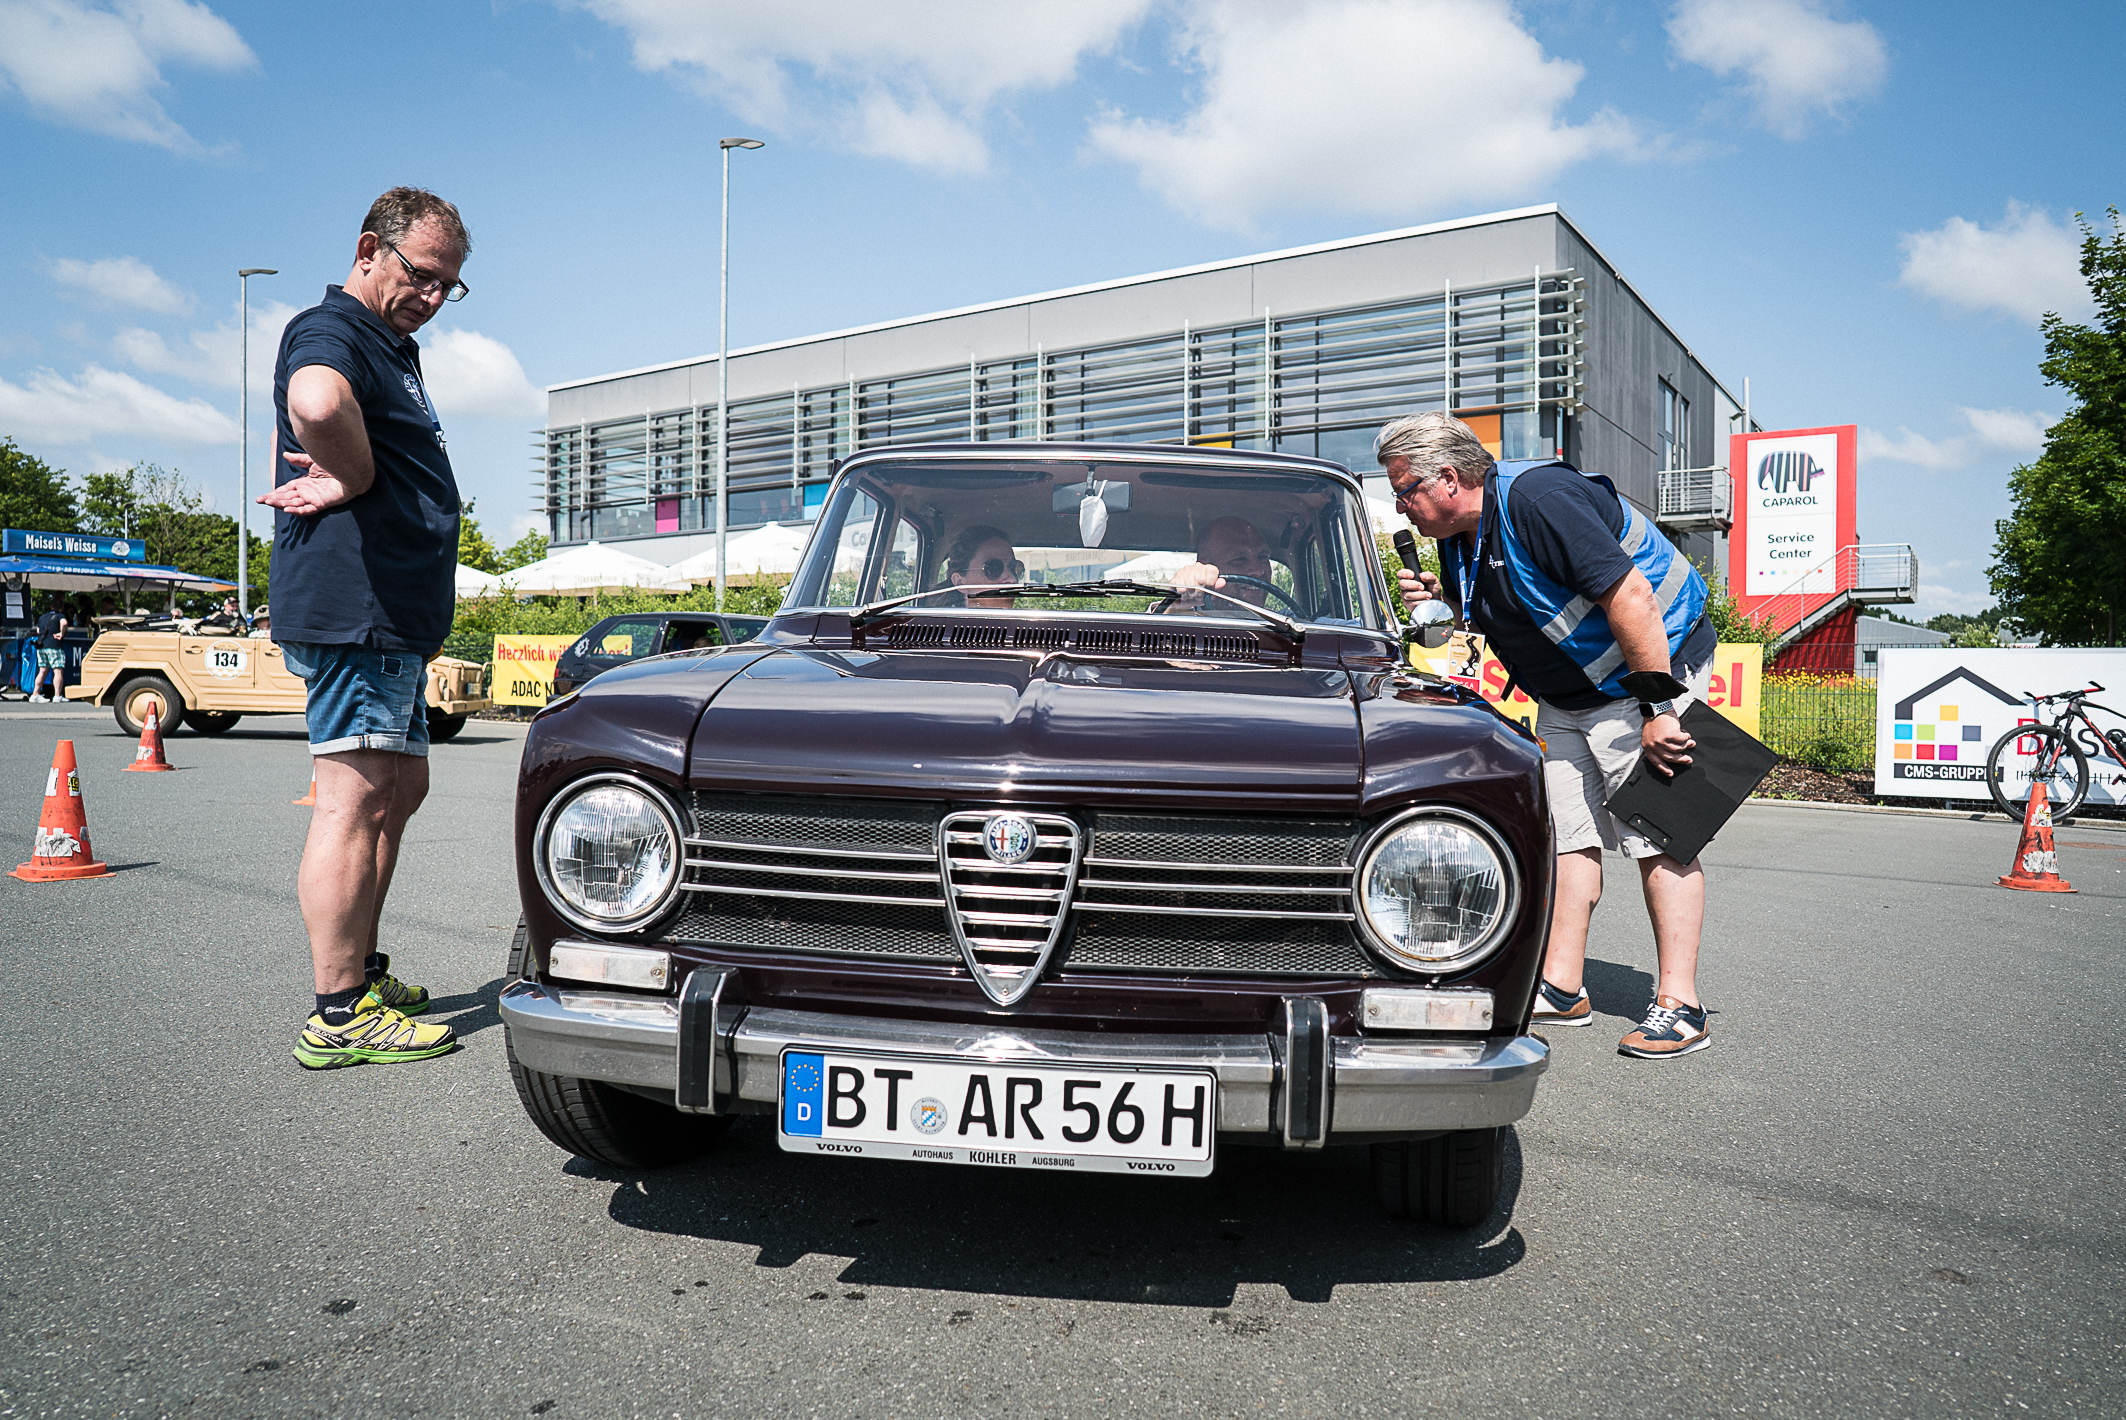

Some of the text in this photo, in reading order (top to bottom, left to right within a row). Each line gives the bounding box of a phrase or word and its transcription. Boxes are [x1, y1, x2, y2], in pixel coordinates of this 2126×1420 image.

[1762, 496, 1818, 508] CAPAROL
[25, 534, 97, 553] Maisel's Weisse
[1767, 532, 1815, 544] Service
[1769, 549, 1812, 559] Center
[214, 652, 239, 668] 134
[498, 643, 545, 661] Herzlich
[511, 680, 541, 697] ADAC
[827, 1066, 913, 1131] BT
[797, 1103, 812, 1121] D
[816, 1142, 863, 1153] VOLVO
[912, 1149, 954, 1160] AUTOHAUS
[1032, 1157, 1075, 1167] AUGSBURG
[1126, 1161, 1176, 1171] VOLVO
